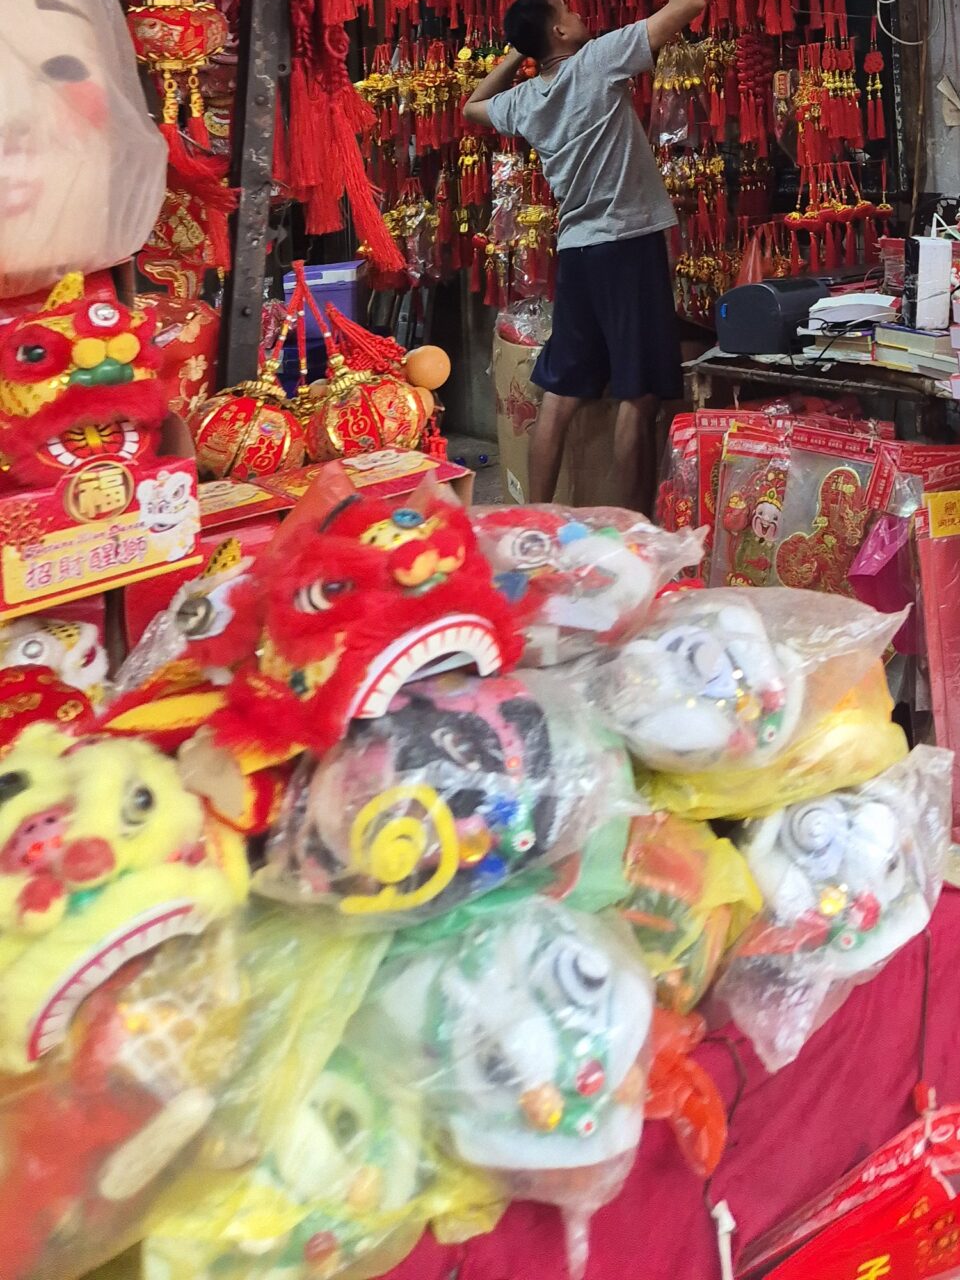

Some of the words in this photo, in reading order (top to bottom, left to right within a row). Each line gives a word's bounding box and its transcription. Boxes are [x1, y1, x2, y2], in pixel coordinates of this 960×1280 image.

[78, 467, 127, 518] 福
[25, 535, 149, 591] 招財醒獅
